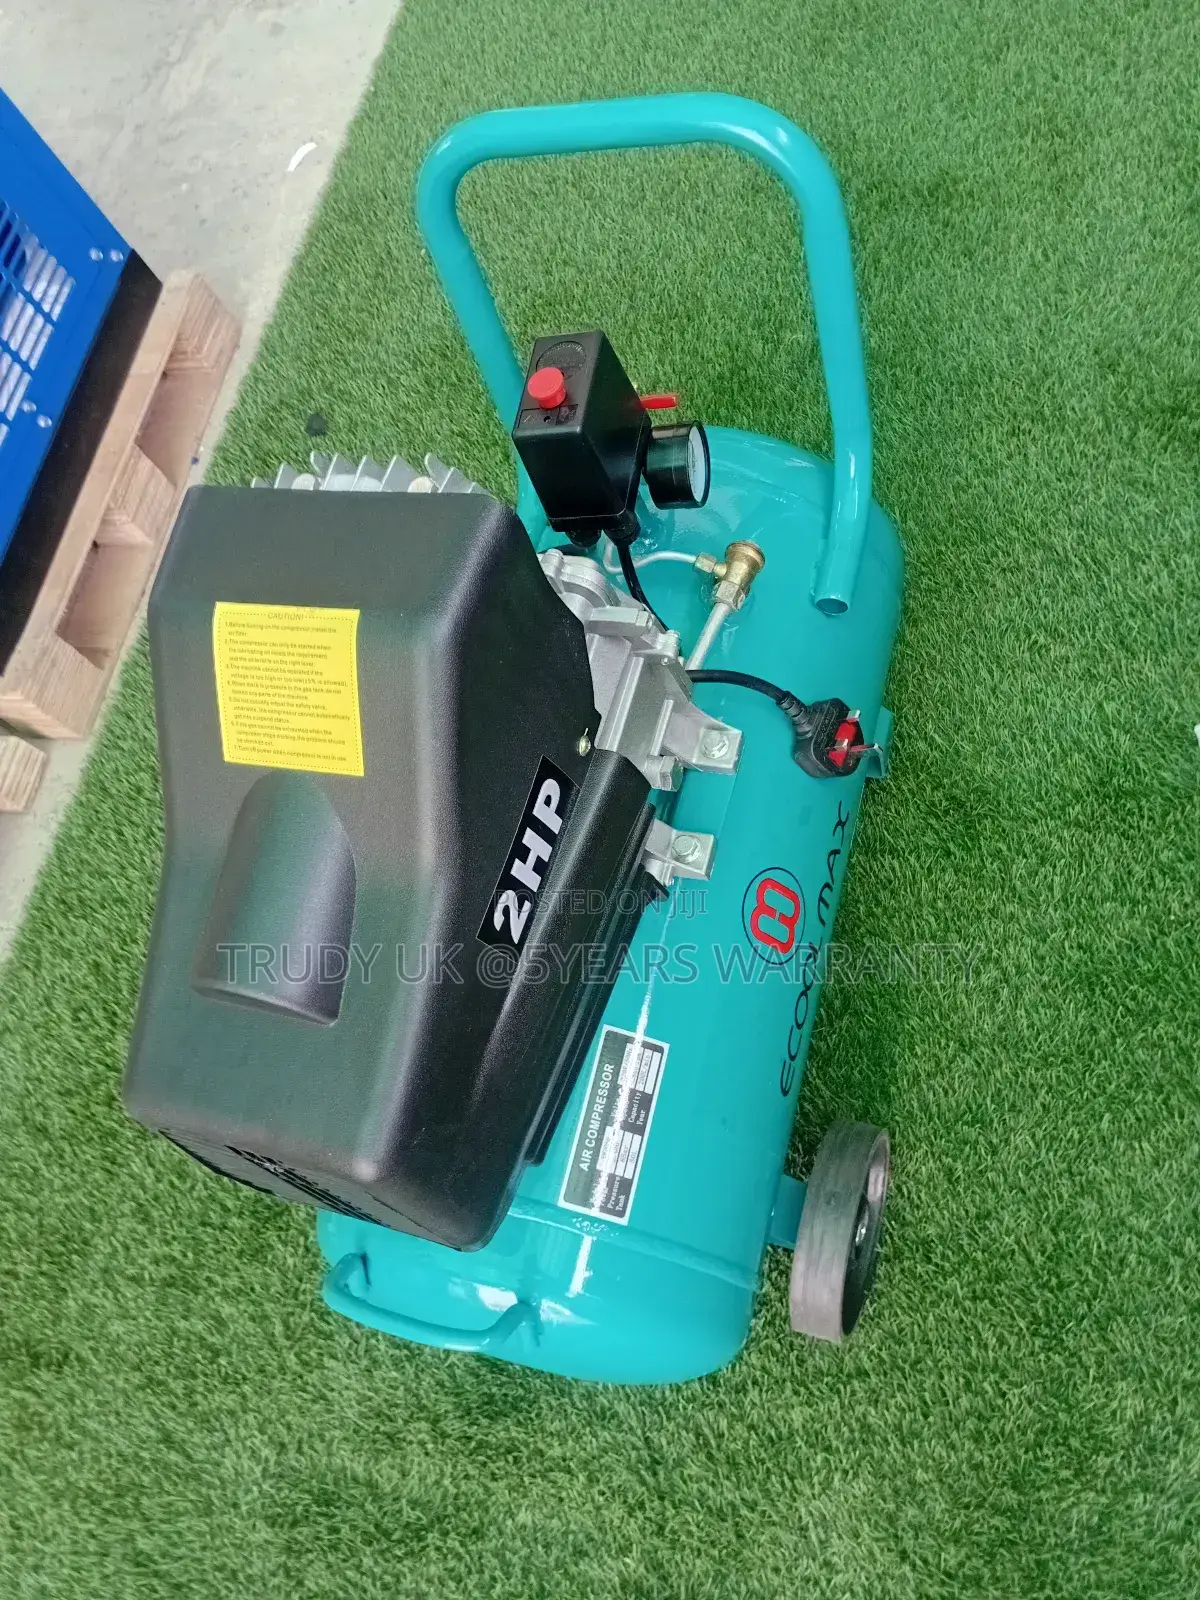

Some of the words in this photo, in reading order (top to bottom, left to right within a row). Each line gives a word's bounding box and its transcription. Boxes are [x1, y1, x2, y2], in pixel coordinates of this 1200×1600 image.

[267, 612, 303, 621] CAUTION!
[494, 779, 563, 944] 2HP
[584, 1063, 615, 1148] COMPRESSOR
[628, 1091, 642, 1123] Capacity
[636, 1109, 646, 1125] Year
[578, 1148, 593, 1172] AIR
[607, 1175, 621, 1209] Pressure
[615, 1193, 626, 1211] Tank
